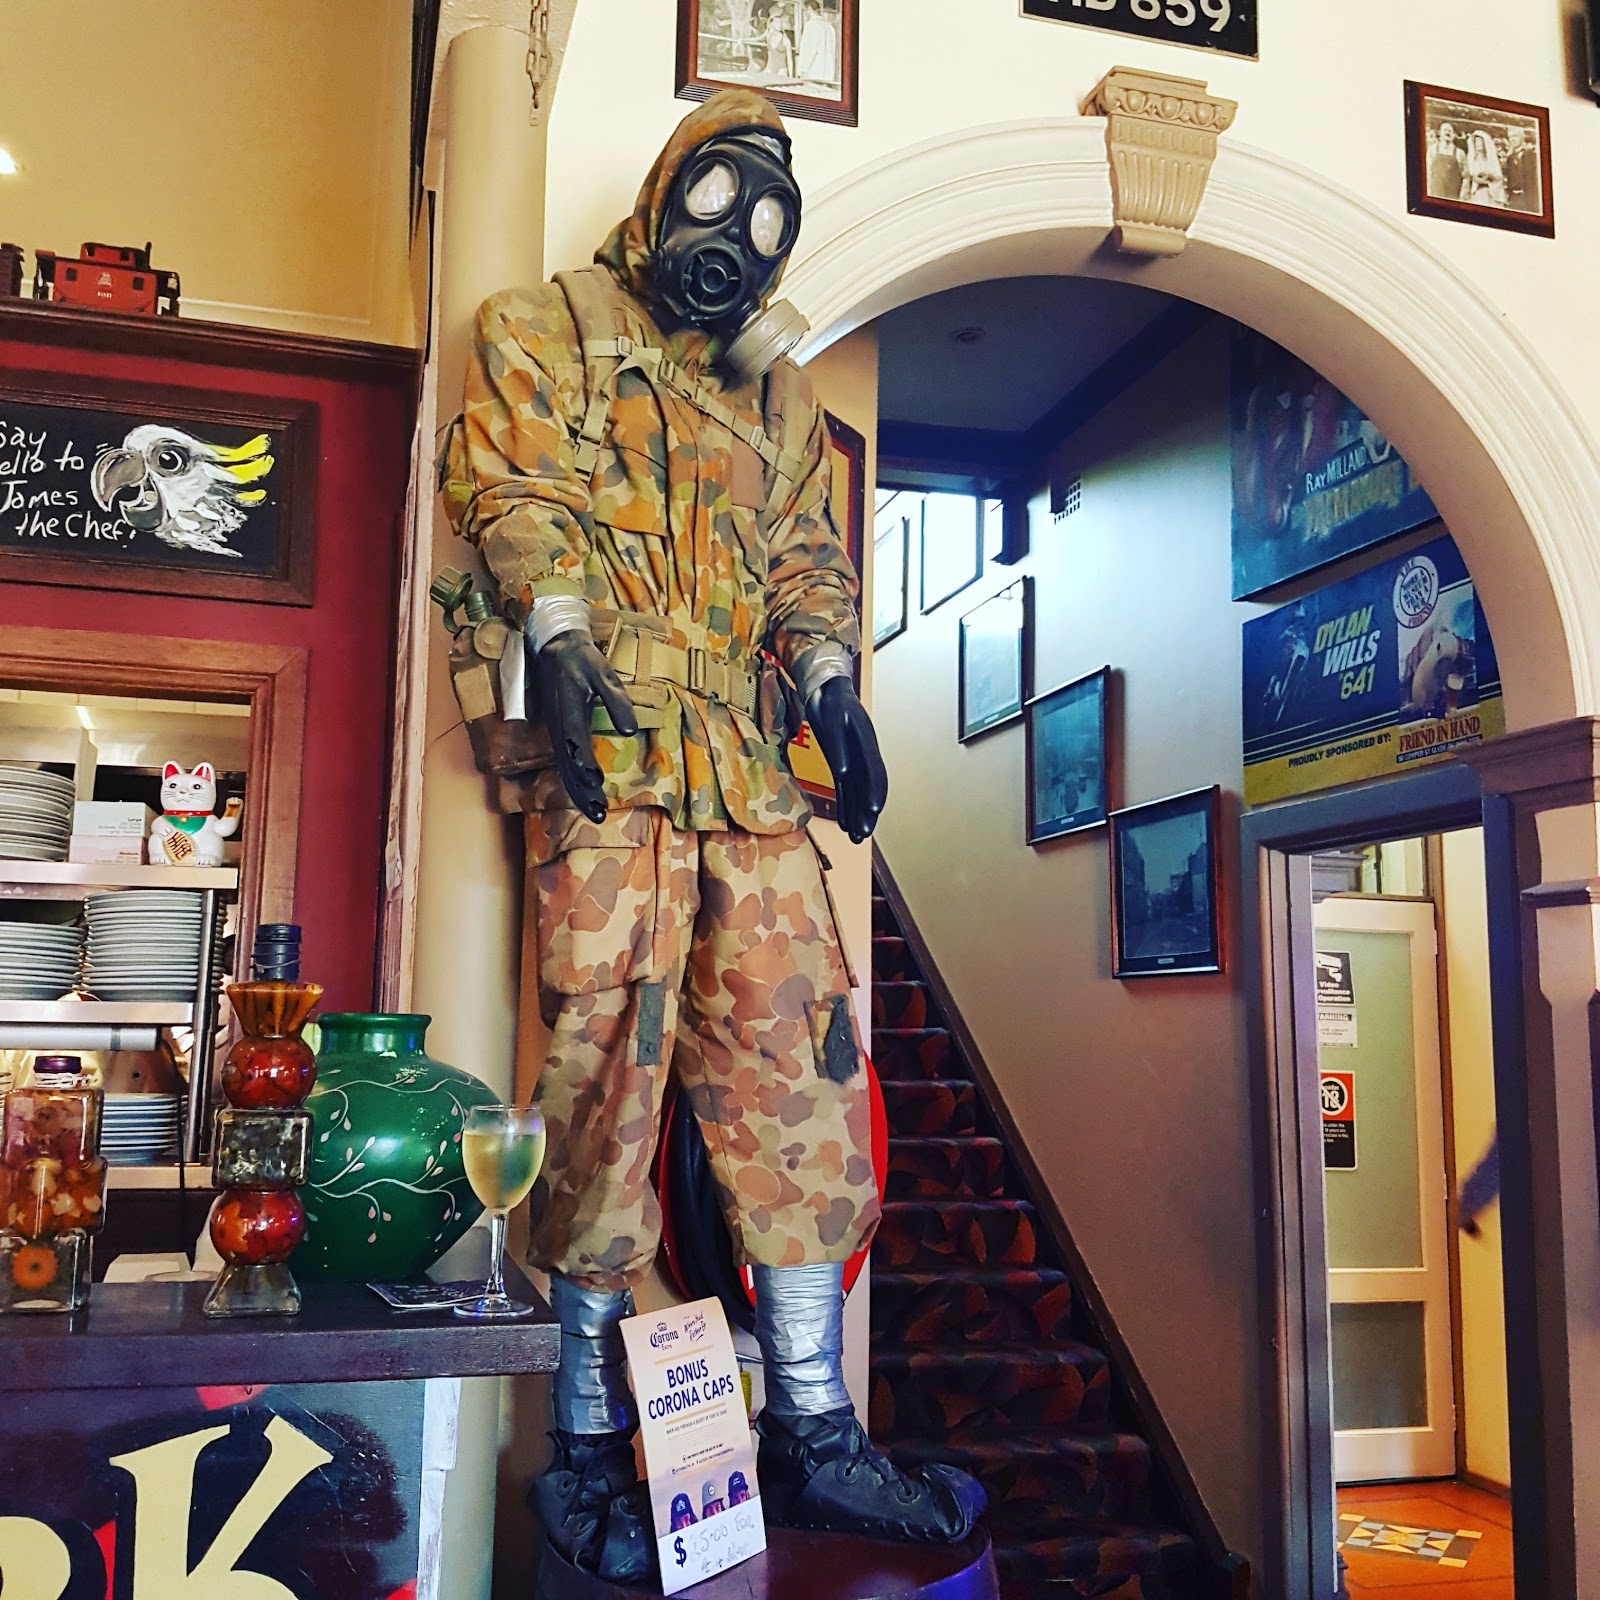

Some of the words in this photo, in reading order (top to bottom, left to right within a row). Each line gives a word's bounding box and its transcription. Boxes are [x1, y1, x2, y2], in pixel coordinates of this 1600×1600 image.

[0, 449, 46, 475] ello
[54, 440, 84, 471] to
[1306, 472, 1326, 494] RAY
[15, 509, 60, 537] the
[1313, 605, 1373, 653] DYLAN
[1322, 630, 1380, 677] WILLS
[1399, 728, 1435, 751] FRIEND
[1436, 722, 1450, 742] IN
[1450, 717, 1480, 739] HAND
[1289, 750, 1324, 768] PROUDLY
[1326, 737, 1375, 758] SPONSORED
[1377, 732, 1392, 745] BY:
[1318, 995, 1351, 1003] Operation
[1319, 981, 1339, 989] Video
[1318, 1013, 1349, 1021] ARNING
[1322, 1090, 1340, 1108] 18
[650, 1330, 679, 1348] Corona
[666, 1358, 709, 1389] BONUS
[648, 1386, 701, 1420] CORONA
[703, 1374, 734, 1401] CAPS
